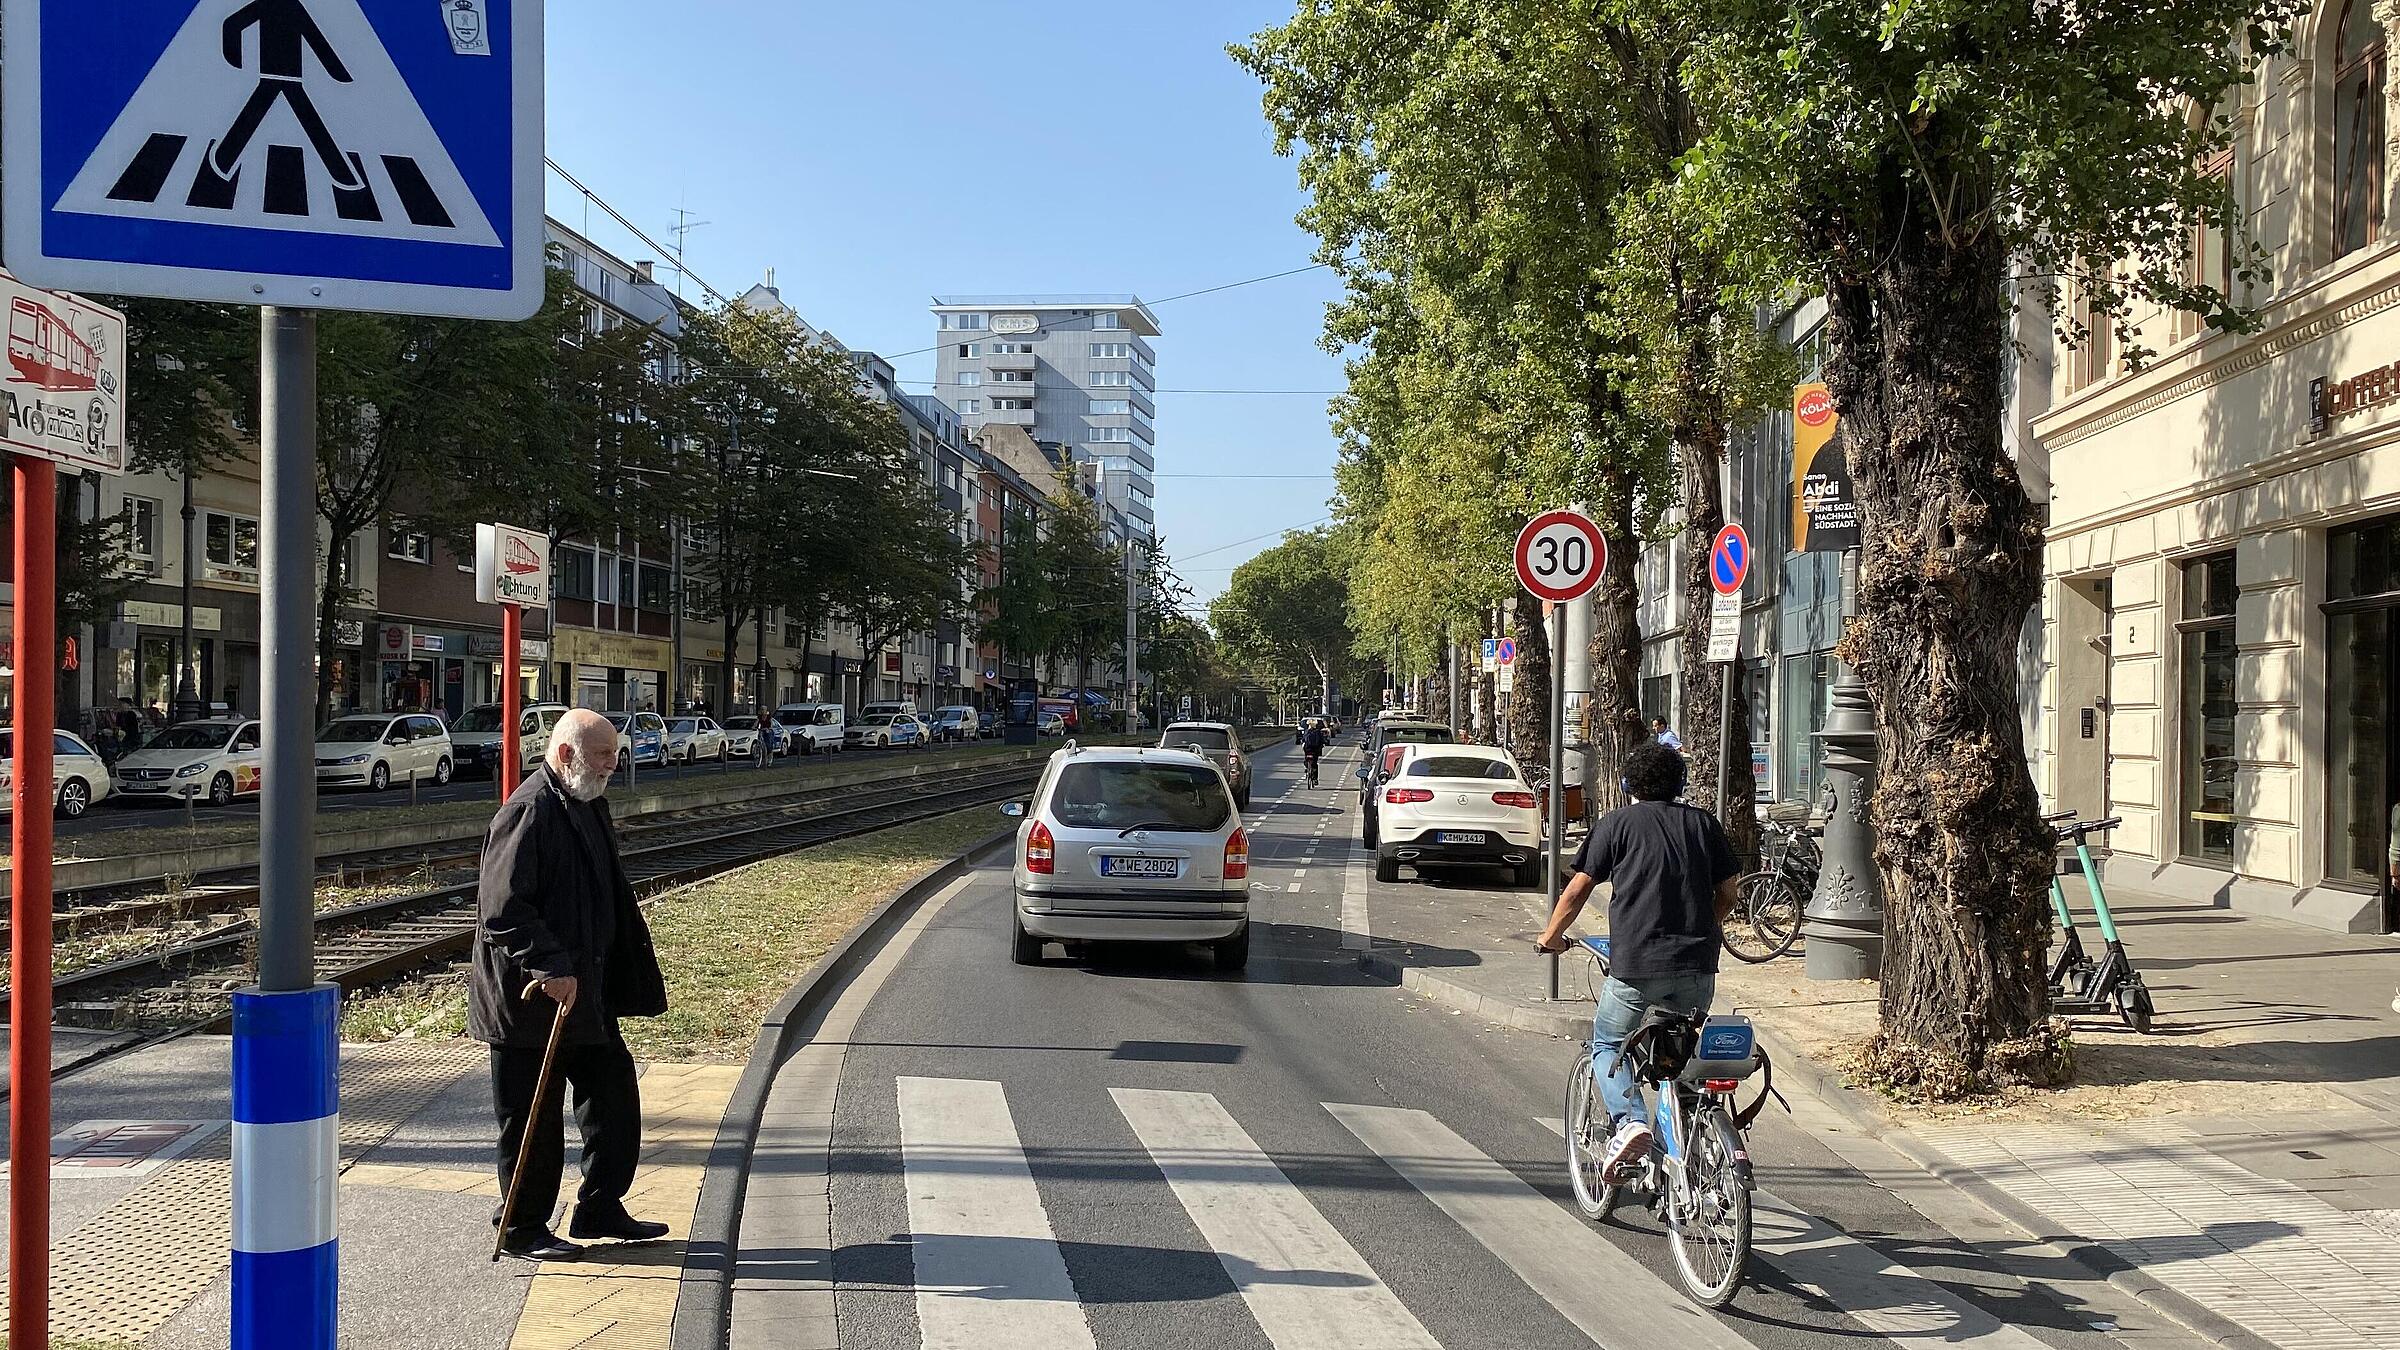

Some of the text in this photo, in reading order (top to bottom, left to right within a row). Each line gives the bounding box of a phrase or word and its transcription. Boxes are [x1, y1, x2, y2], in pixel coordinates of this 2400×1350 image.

[1800, 400, 1831, 417] KÖLN
[1803, 480, 1840, 497] Abdi
[1815, 504, 1833, 513] EINE
[1814, 519, 1858, 530] SÜDSTADT.
[1534, 535, 1587, 577] 30
[509, 577, 542, 601] chtung!
[2129, 625, 2135, 644] 2
[1484, 641, 1493, 657] P
[1109, 858, 1175, 873] K WE 2802
